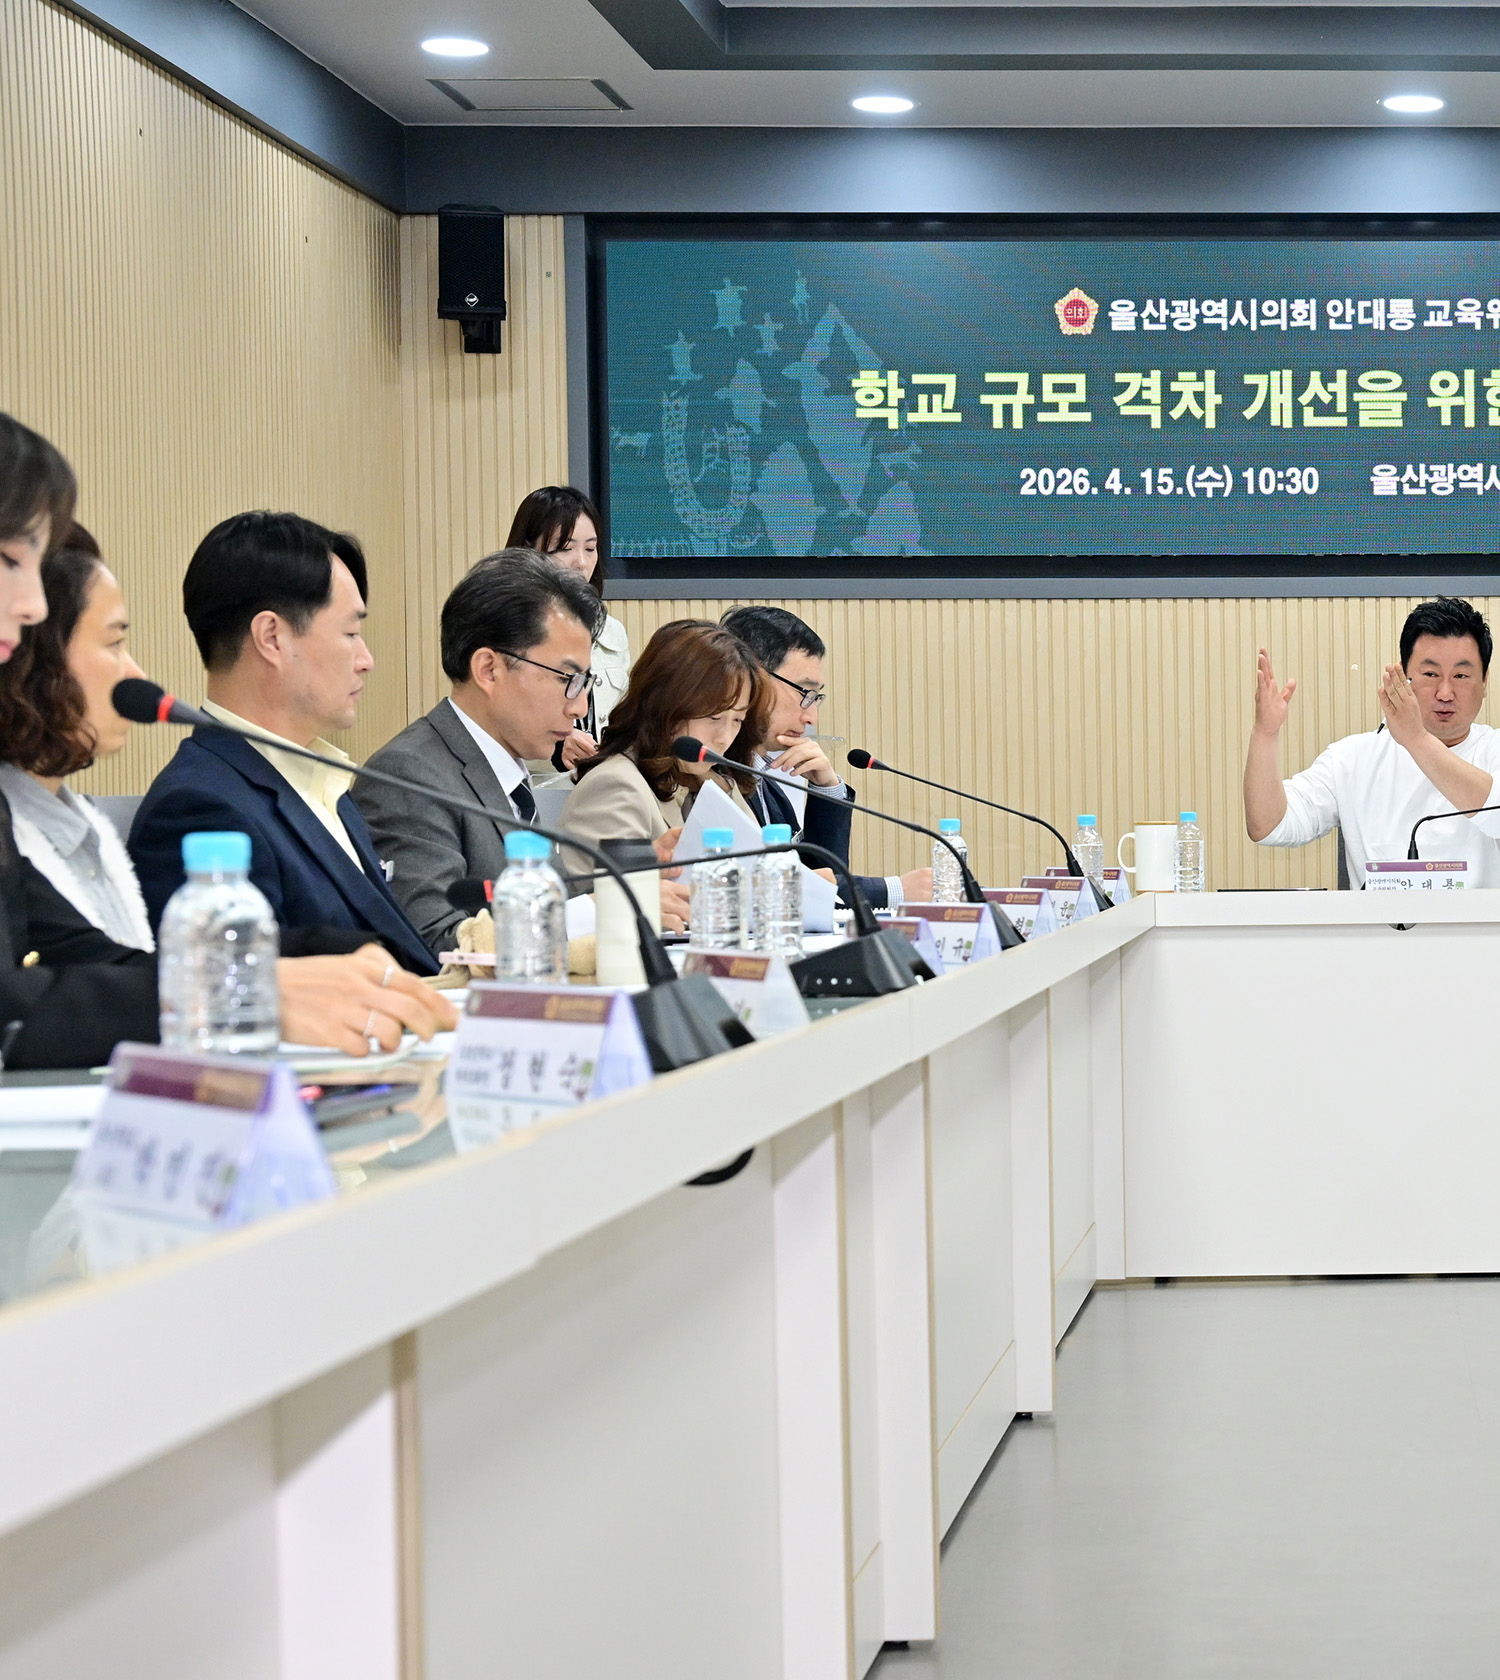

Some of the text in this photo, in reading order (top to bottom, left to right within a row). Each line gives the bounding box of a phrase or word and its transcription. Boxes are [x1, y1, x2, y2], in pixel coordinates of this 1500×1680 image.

[1065, 305, 1088, 319] 의회
[1108, 298, 1317, 332] 울산광역시의회
[1326, 298, 1416, 331] 안대룡
[851, 370, 962, 430] 학교
[979, 372, 1092, 429] 규모
[1112, 369, 1223, 429] 격차
[1242, 369, 1408, 429] 개선을
[1020, 467, 1098, 496] 2026.
[1104, 468, 1132, 495] 4.
[1242, 466, 1319, 495] 10:30
